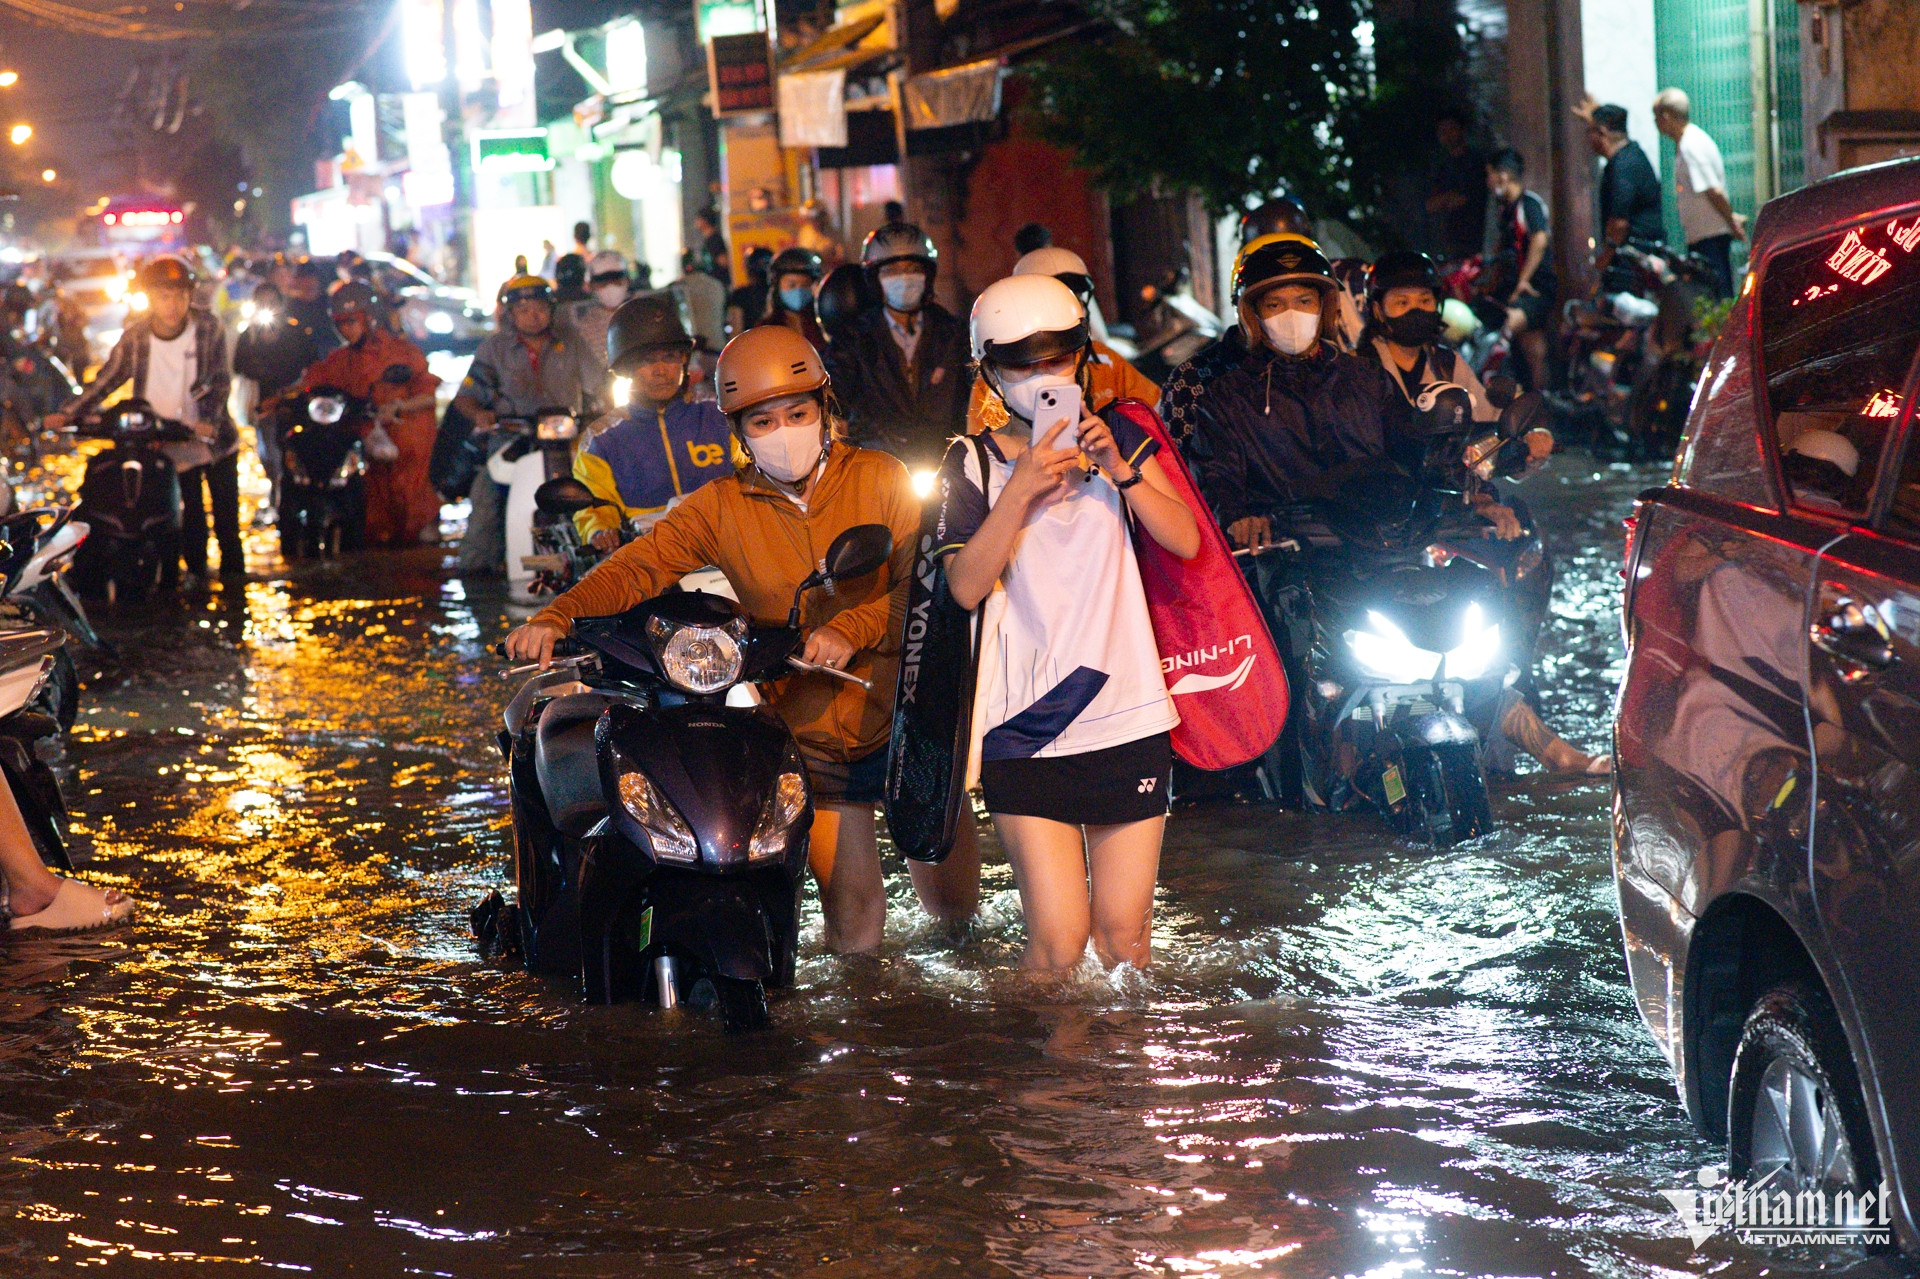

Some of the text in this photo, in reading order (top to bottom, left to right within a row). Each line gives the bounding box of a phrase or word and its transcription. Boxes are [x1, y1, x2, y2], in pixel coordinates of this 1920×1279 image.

[686, 440, 725, 468] be
[937, 500, 948, 540] YONEX
[902, 599, 932, 705] YONEX
[1161, 634, 1252, 673] LI-NING
